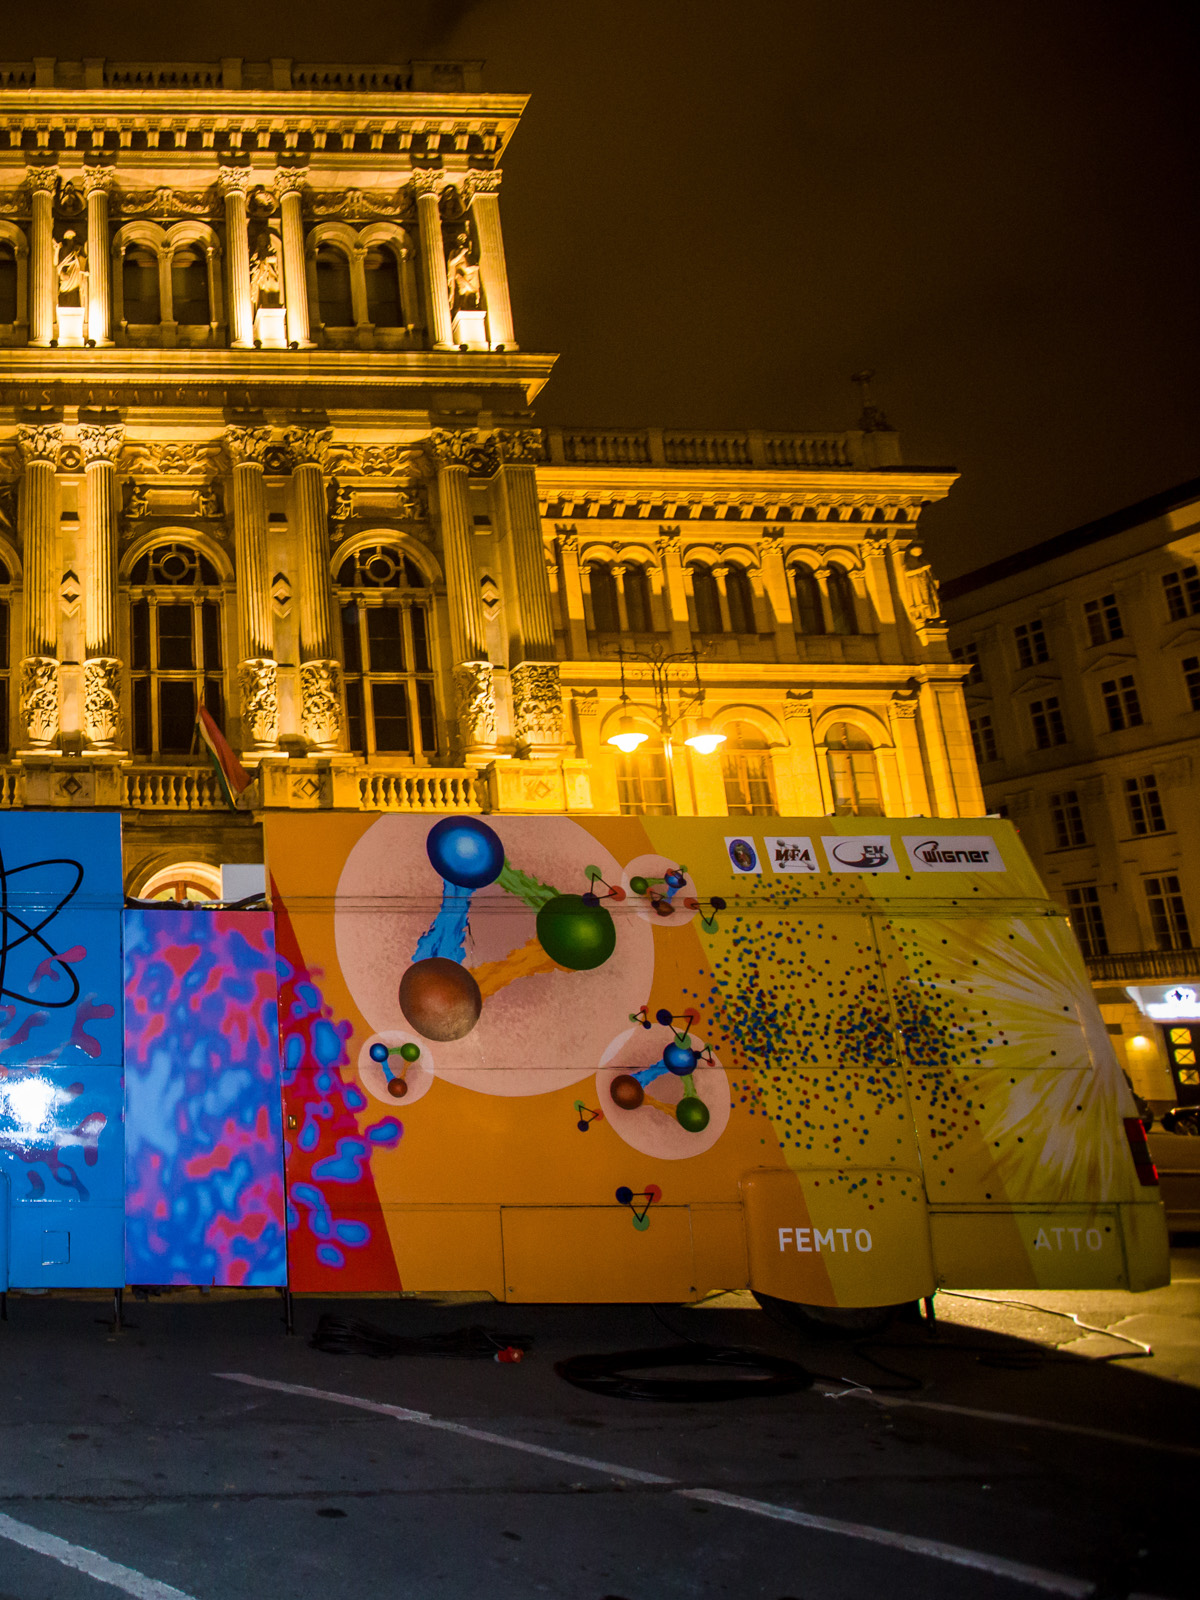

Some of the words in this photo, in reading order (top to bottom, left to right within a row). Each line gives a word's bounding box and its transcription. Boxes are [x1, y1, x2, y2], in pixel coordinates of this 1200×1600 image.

[774, 848, 811, 862] MFA
[777, 1227, 873, 1252] FEMTO
[1034, 1227, 1102, 1251] ATTO
